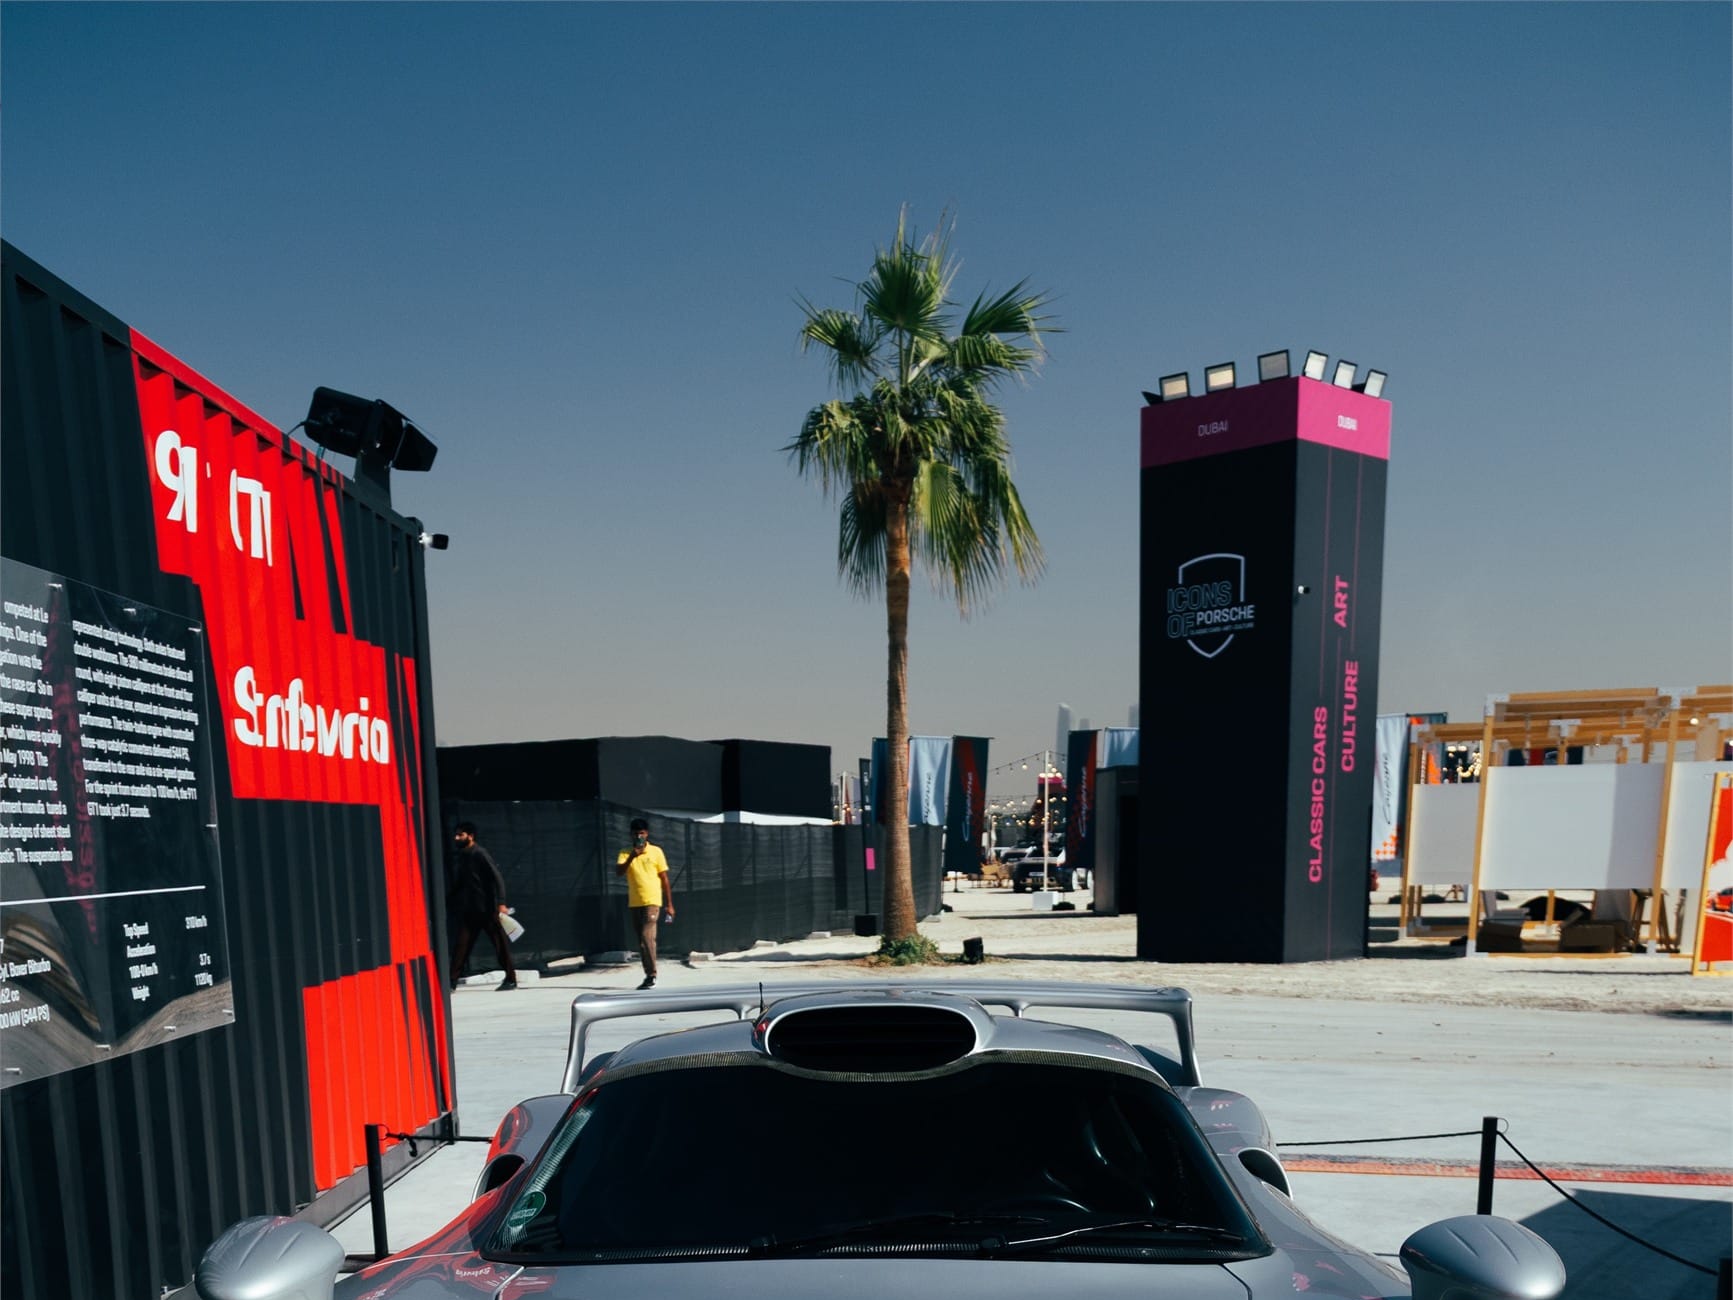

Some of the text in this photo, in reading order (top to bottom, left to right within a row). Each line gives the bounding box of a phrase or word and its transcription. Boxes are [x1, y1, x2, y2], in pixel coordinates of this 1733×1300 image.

[1198, 420, 1229, 437] DUBAI
[1167, 580, 1232, 614] ICONS
[1333, 575, 1349, 628] ART
[1167, 604, 1256, 638] OF PORSCHE
[1341, 660, 1359, 773] CULTURE
[1308, 705, 1328, 884] CLASSIC CARS
